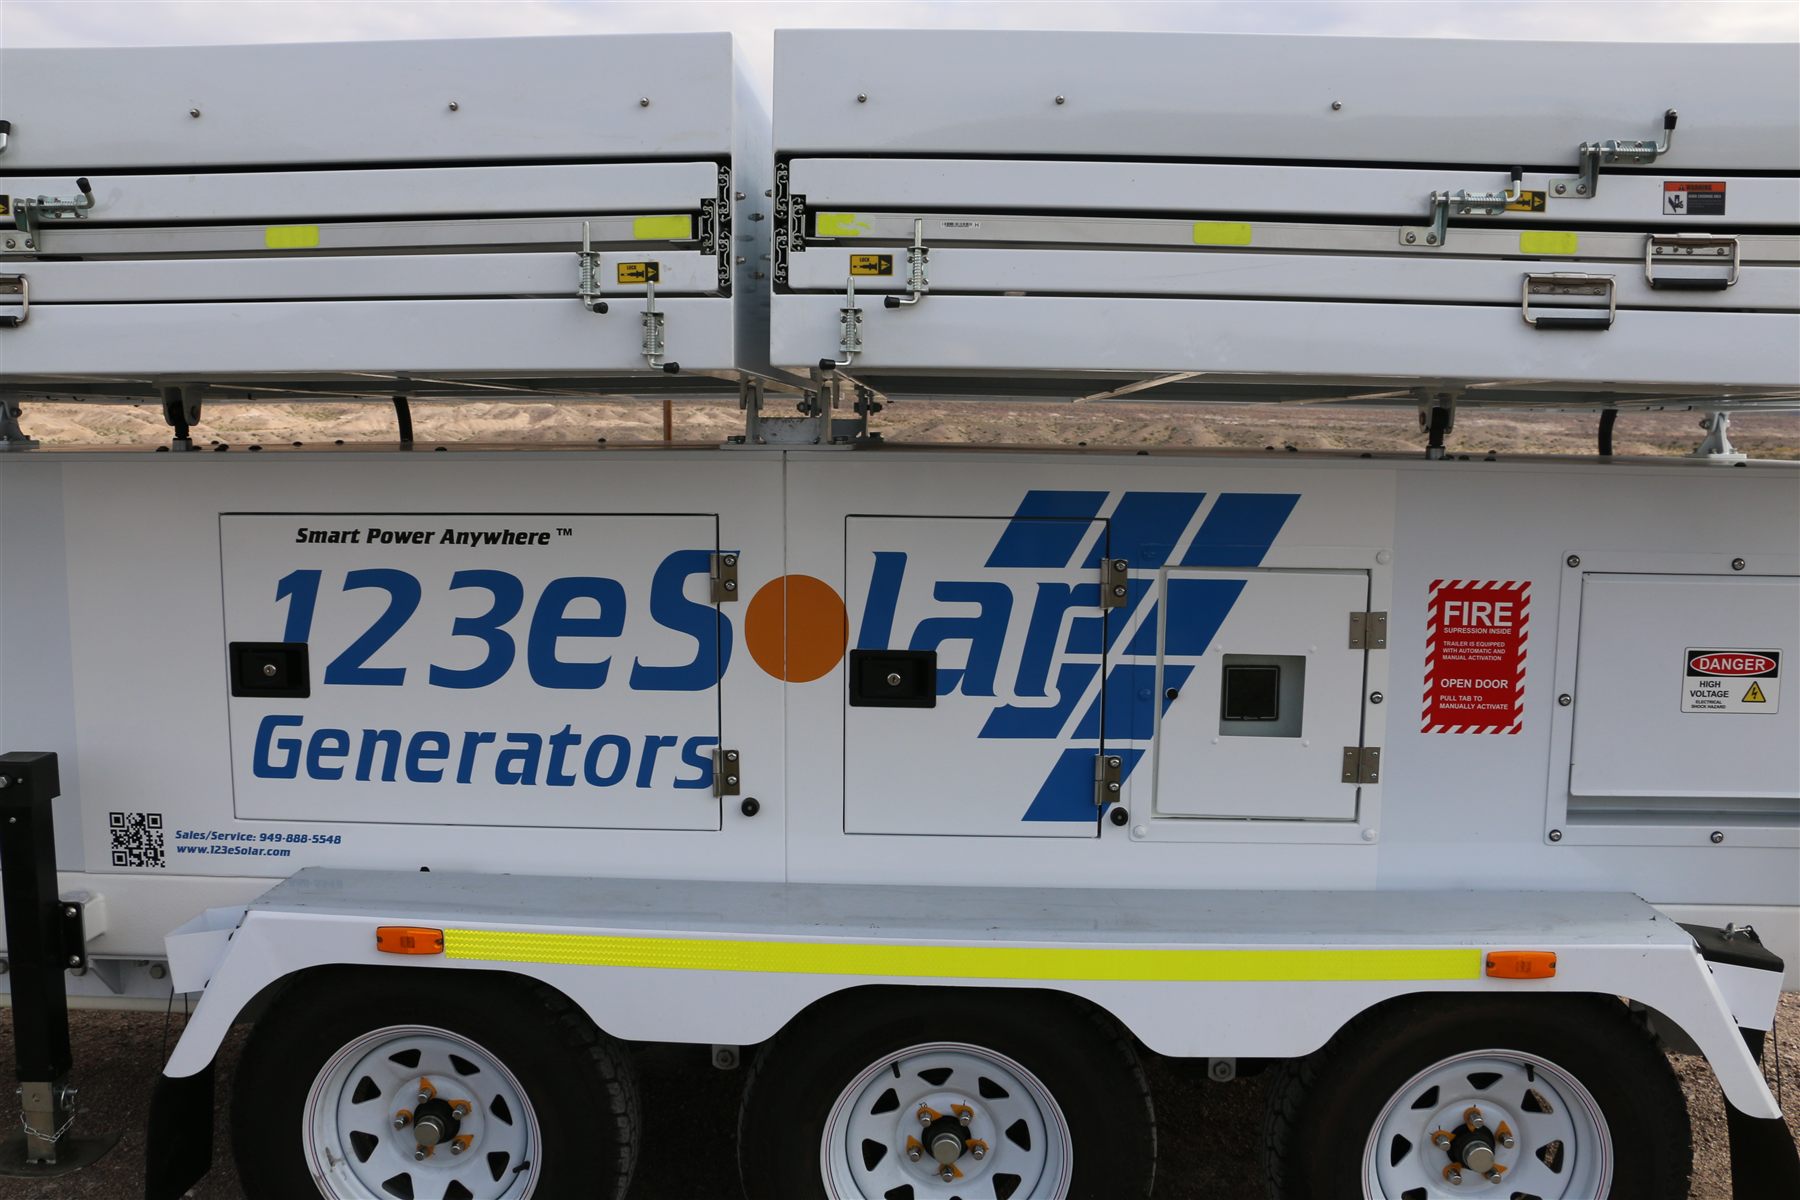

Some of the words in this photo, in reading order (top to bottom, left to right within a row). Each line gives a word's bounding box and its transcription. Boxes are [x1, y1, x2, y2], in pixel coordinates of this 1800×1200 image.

[296, 528, 359, 544] Smart
[366, 528, 435, 545] Power
[440, 528, 551, 547] Anywhere
[1444, 601, 1513, 626] FIRE
[1443, 627, 1488, 635] SUPRESSION
[1699, 657, 1766, 671] DANGER
[1440, 678, 1472, 688] OPEN
[1475, 679, 1508, 688] DOOR
[1699, 680, 1721, 688] HIGH
[1689, 690, 1729, 698] VOLTAGE
[252, 714, 720, 790] Generators
[175, 830, 256, 842] Sales/Service:
[259, 832, 341, 844] 949-888-5548
[176, 845, 291, 857] www.123eSolar.com
